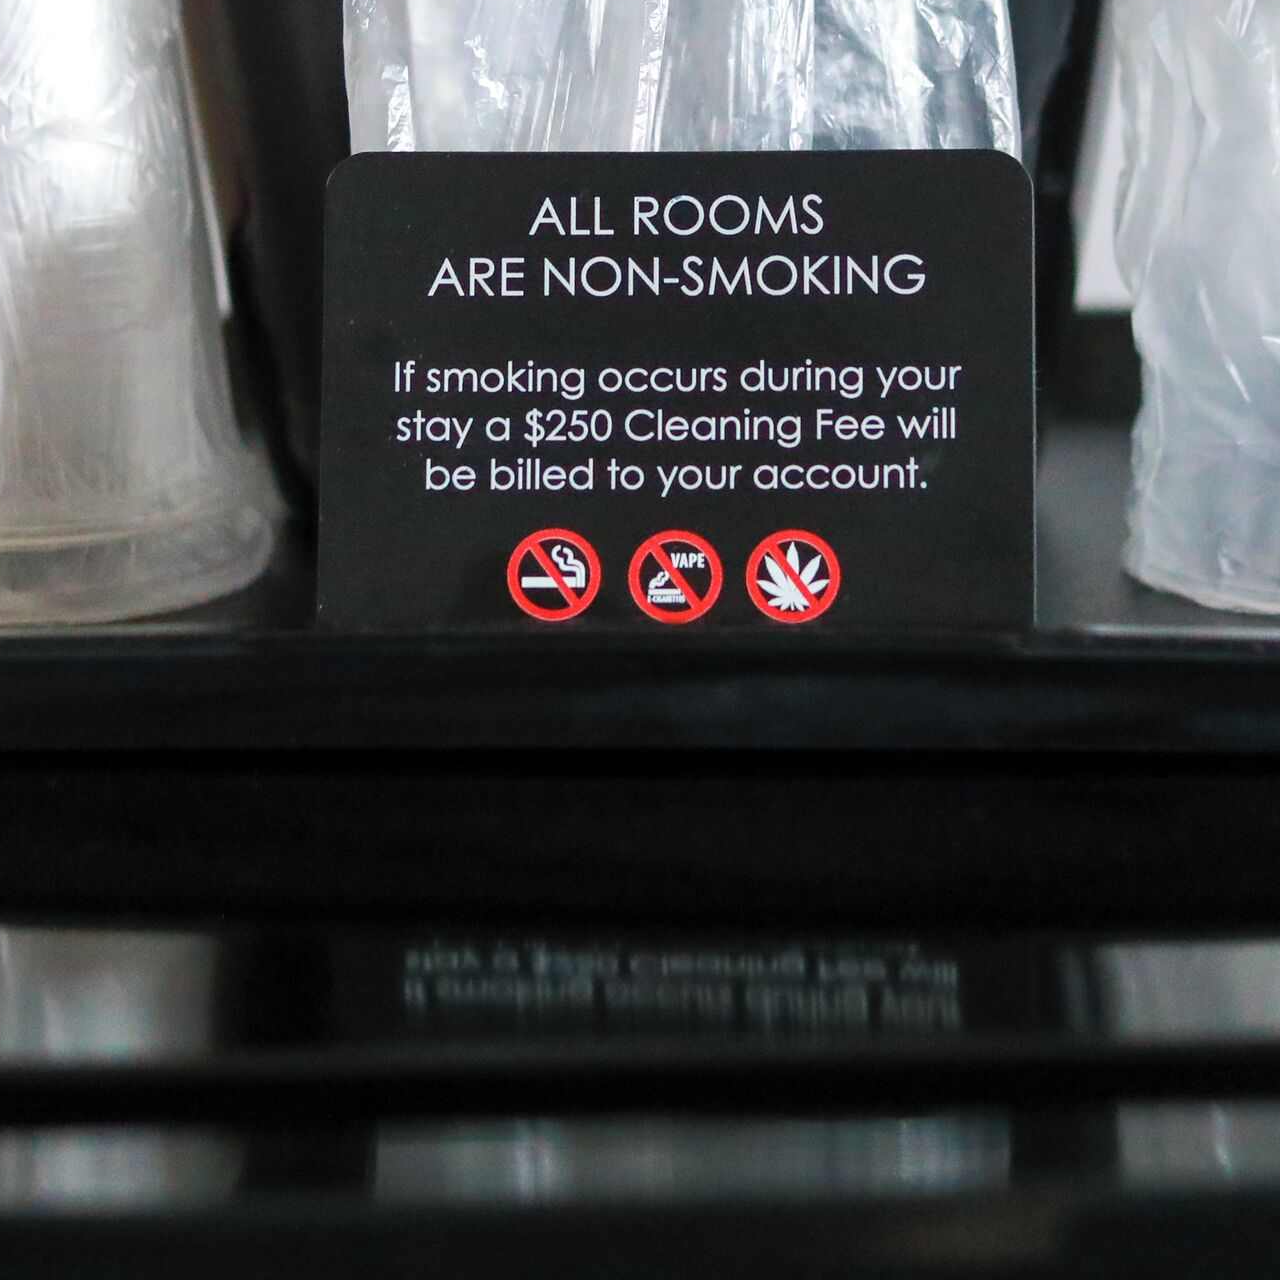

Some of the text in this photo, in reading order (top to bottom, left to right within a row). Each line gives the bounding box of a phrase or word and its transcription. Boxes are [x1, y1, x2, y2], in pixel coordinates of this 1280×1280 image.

[528, 193, 824, 236] ALL ROOMS
[427, 253, 926, 297] ARE NON-SMOKING
[394, 357, 962, 401] If smoking occurs during your
[396, 406, 956, 450] stay a $250 Cleaning Fee will
[425, 456, 928, 498] be billed to your account.
[670, 552, 705, 568] VAPE
